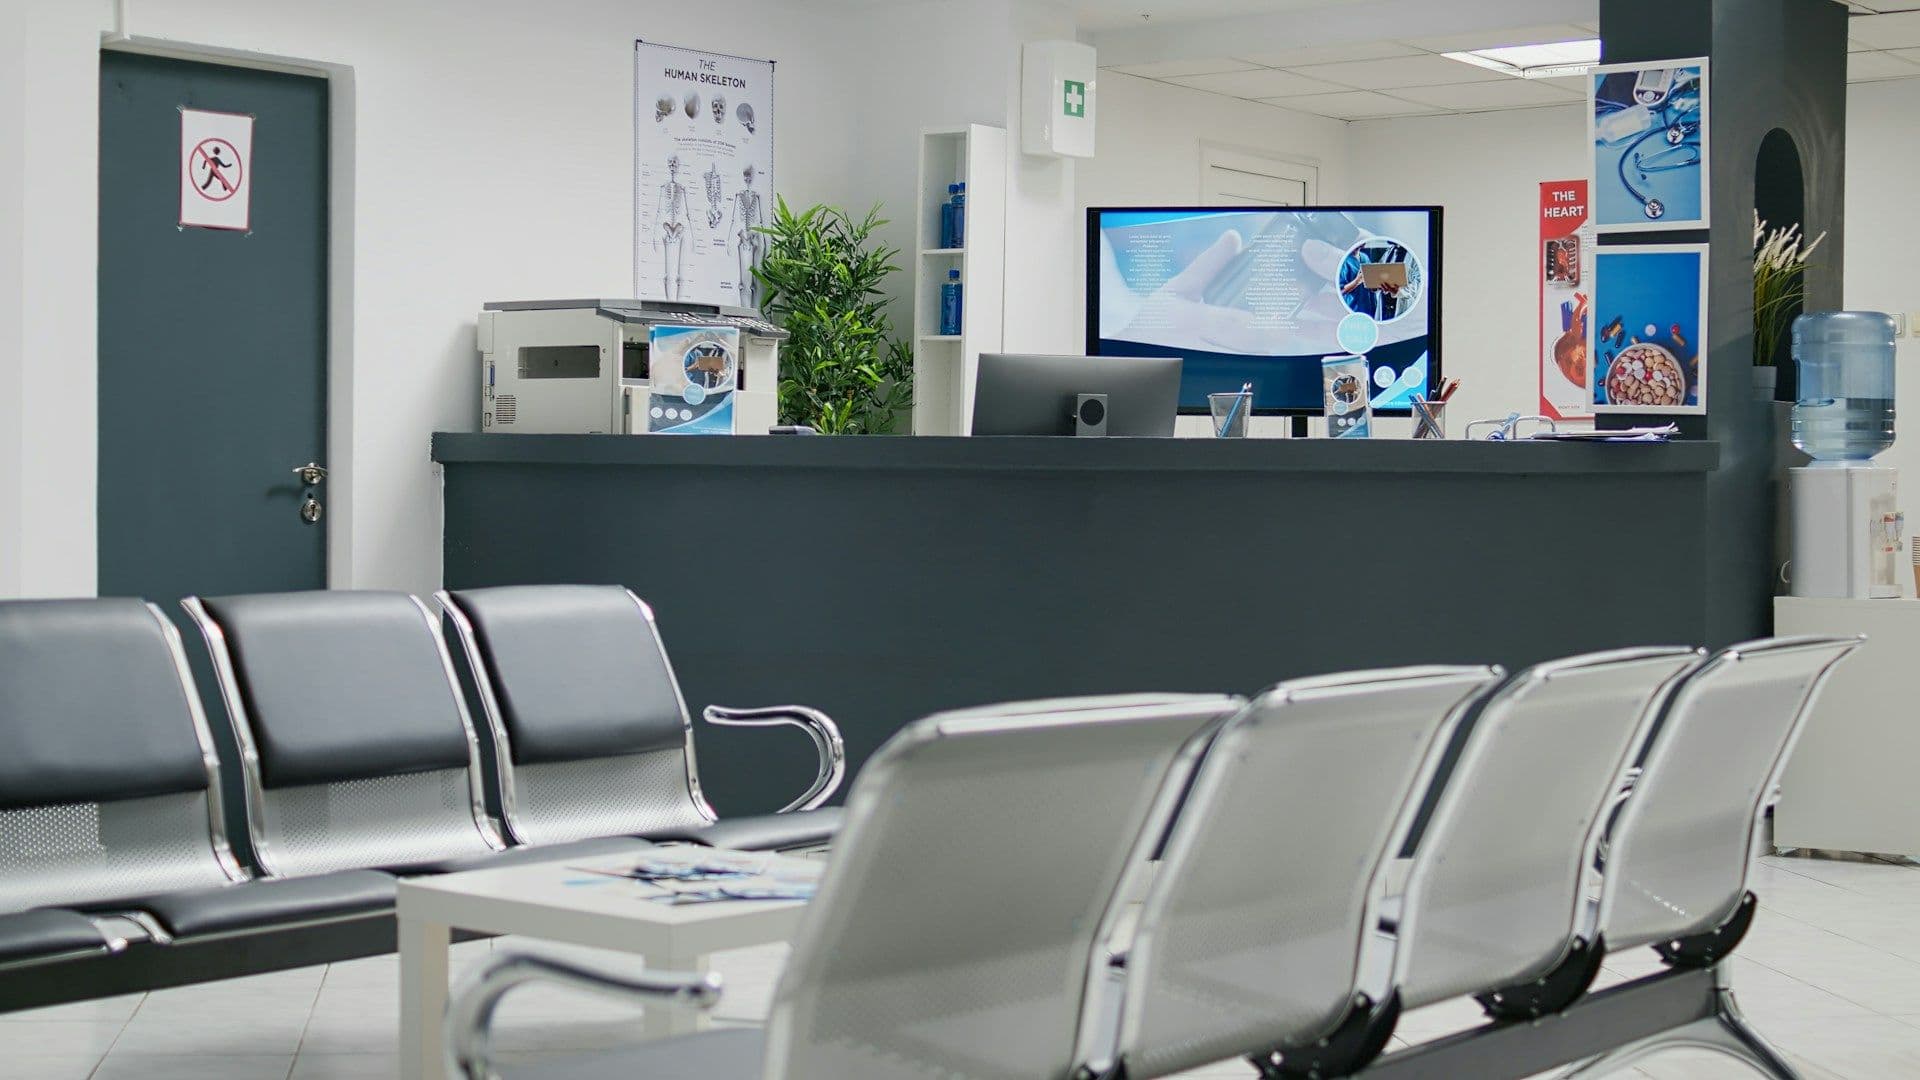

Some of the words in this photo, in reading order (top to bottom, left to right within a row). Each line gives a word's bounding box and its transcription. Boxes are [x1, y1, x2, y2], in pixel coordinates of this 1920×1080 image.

[699, 59, 716, 72] THE
[664, 68, 698, 82] HUMAN
[699, 73, 746, 89] SKELETON
[1552, 190, 1576, 202] THE
[1544, 205, 1584, 218] HEART
